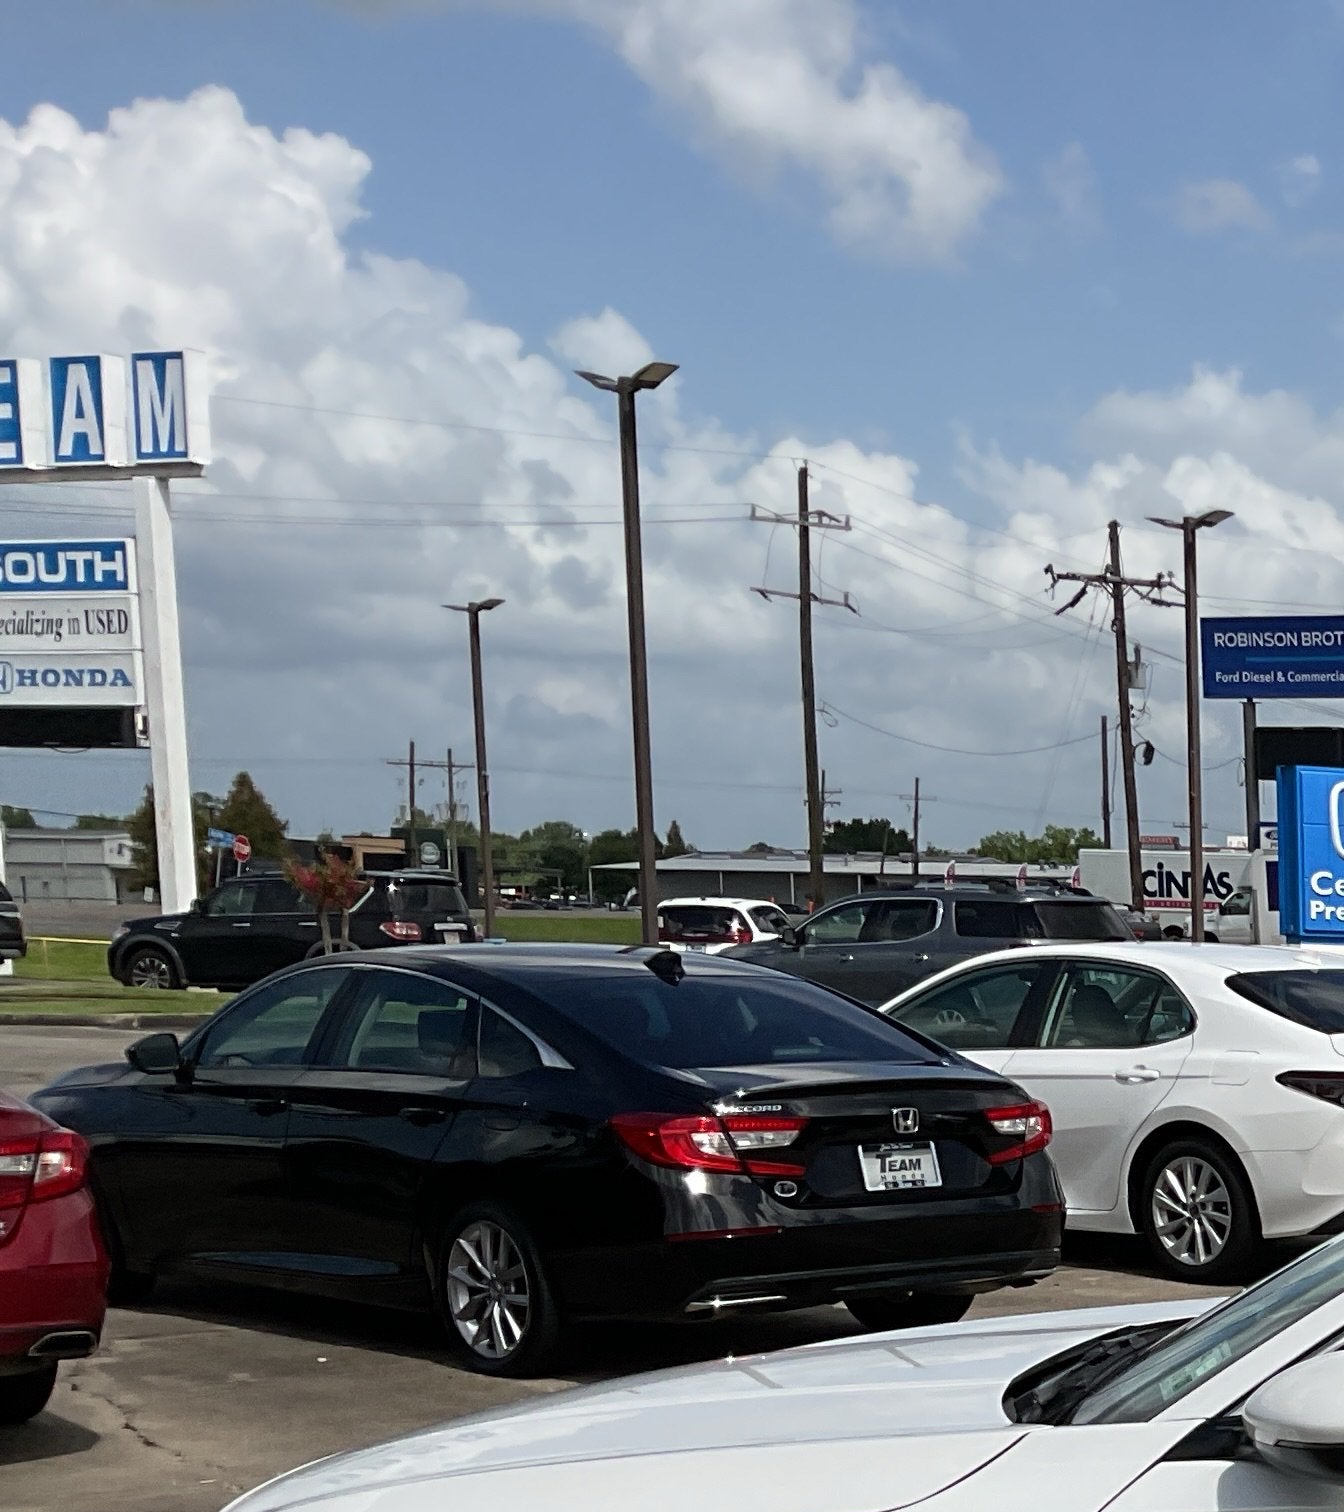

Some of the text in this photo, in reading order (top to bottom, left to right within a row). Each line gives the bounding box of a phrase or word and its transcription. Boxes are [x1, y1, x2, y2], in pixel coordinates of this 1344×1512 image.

[0, 550, 124, 583] OUTH
[67, 608, 80, 635] in
[84, 608, 128, 635] USED
[1214, 632, 1298, 648] ROBINSON
[15, 668, 133, 687] HONDA
[1216, 671, 1239, 683] Ford
[1242, 670, 1275, 683] Diesel
[1277, 671, 1285, 683] &
[875, 1153, 922, 1173] TEAM
